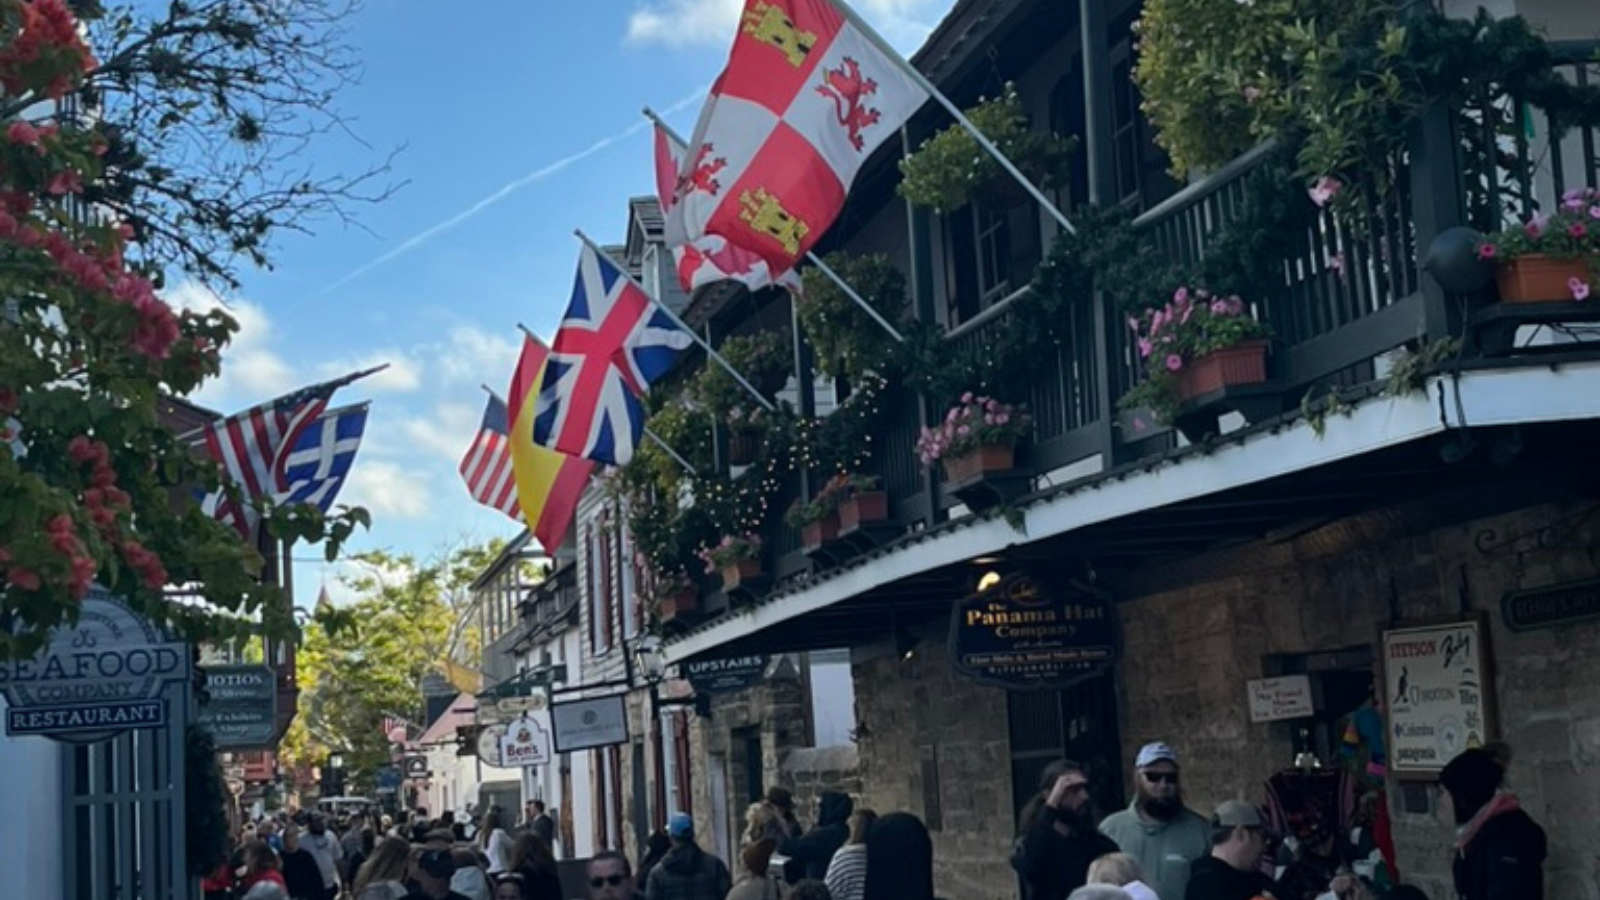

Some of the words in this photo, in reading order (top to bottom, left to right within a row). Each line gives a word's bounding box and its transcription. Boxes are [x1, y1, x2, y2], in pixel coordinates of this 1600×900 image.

[966, 610, 1056, 626] Panama
[1064, 604, 1103, 620] Hat
[995, 626, 1077, 640] Company
[1389, 641, 1436, 658] STETSON
[688, 655, 762, 673] UPSTAIRS
[37, 682, 134, 700] COMPANY
[13, 704, 158, 728] RESTAURANT
